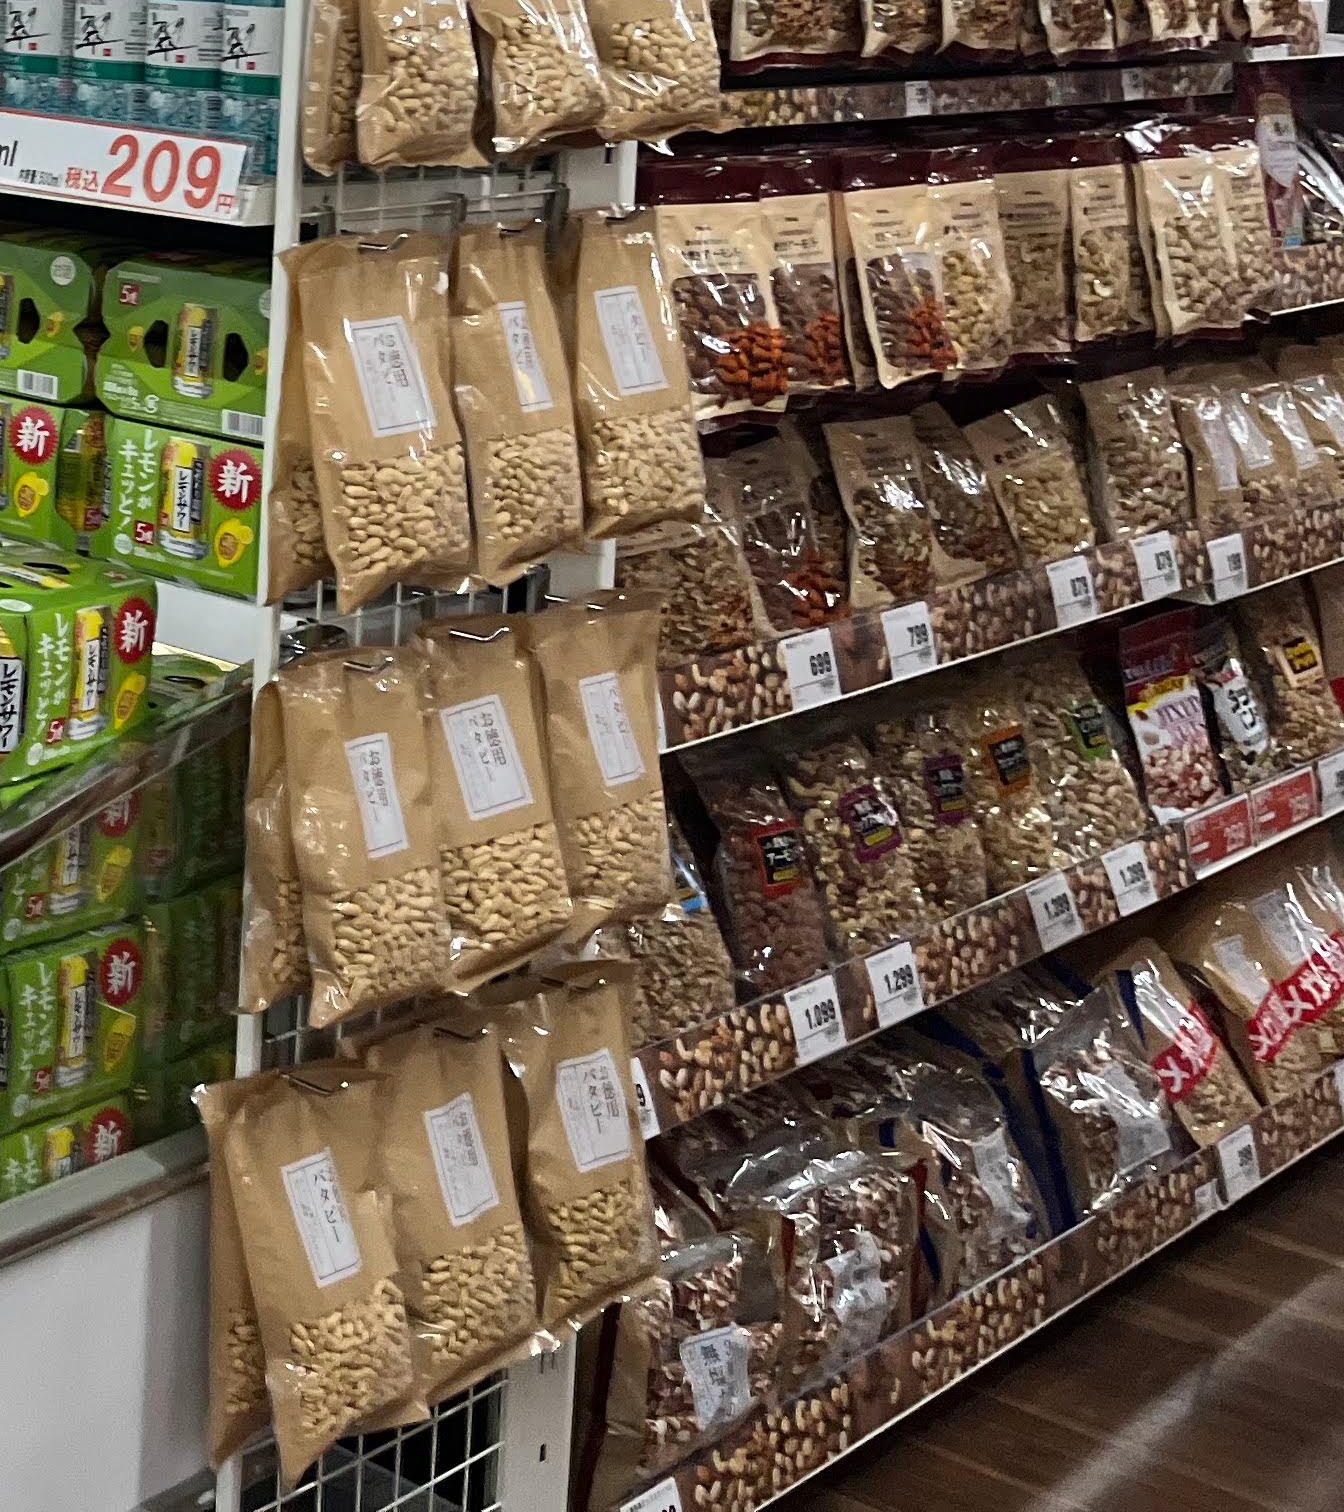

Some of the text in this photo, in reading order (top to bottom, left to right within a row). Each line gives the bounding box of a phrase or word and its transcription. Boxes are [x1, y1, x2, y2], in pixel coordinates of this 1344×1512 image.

[65, 167, 100, 192] 税込
[101, 134, 221, 209] 209
[215, 193, 240, 214] 円
[15, 419, 51, 457] 新
[217, 459, 255, 503] 新
[119, 609, 149, 654] 新
[106, 951, 137, 997] 新
[582, 1066, 605, 1136] バタピー
